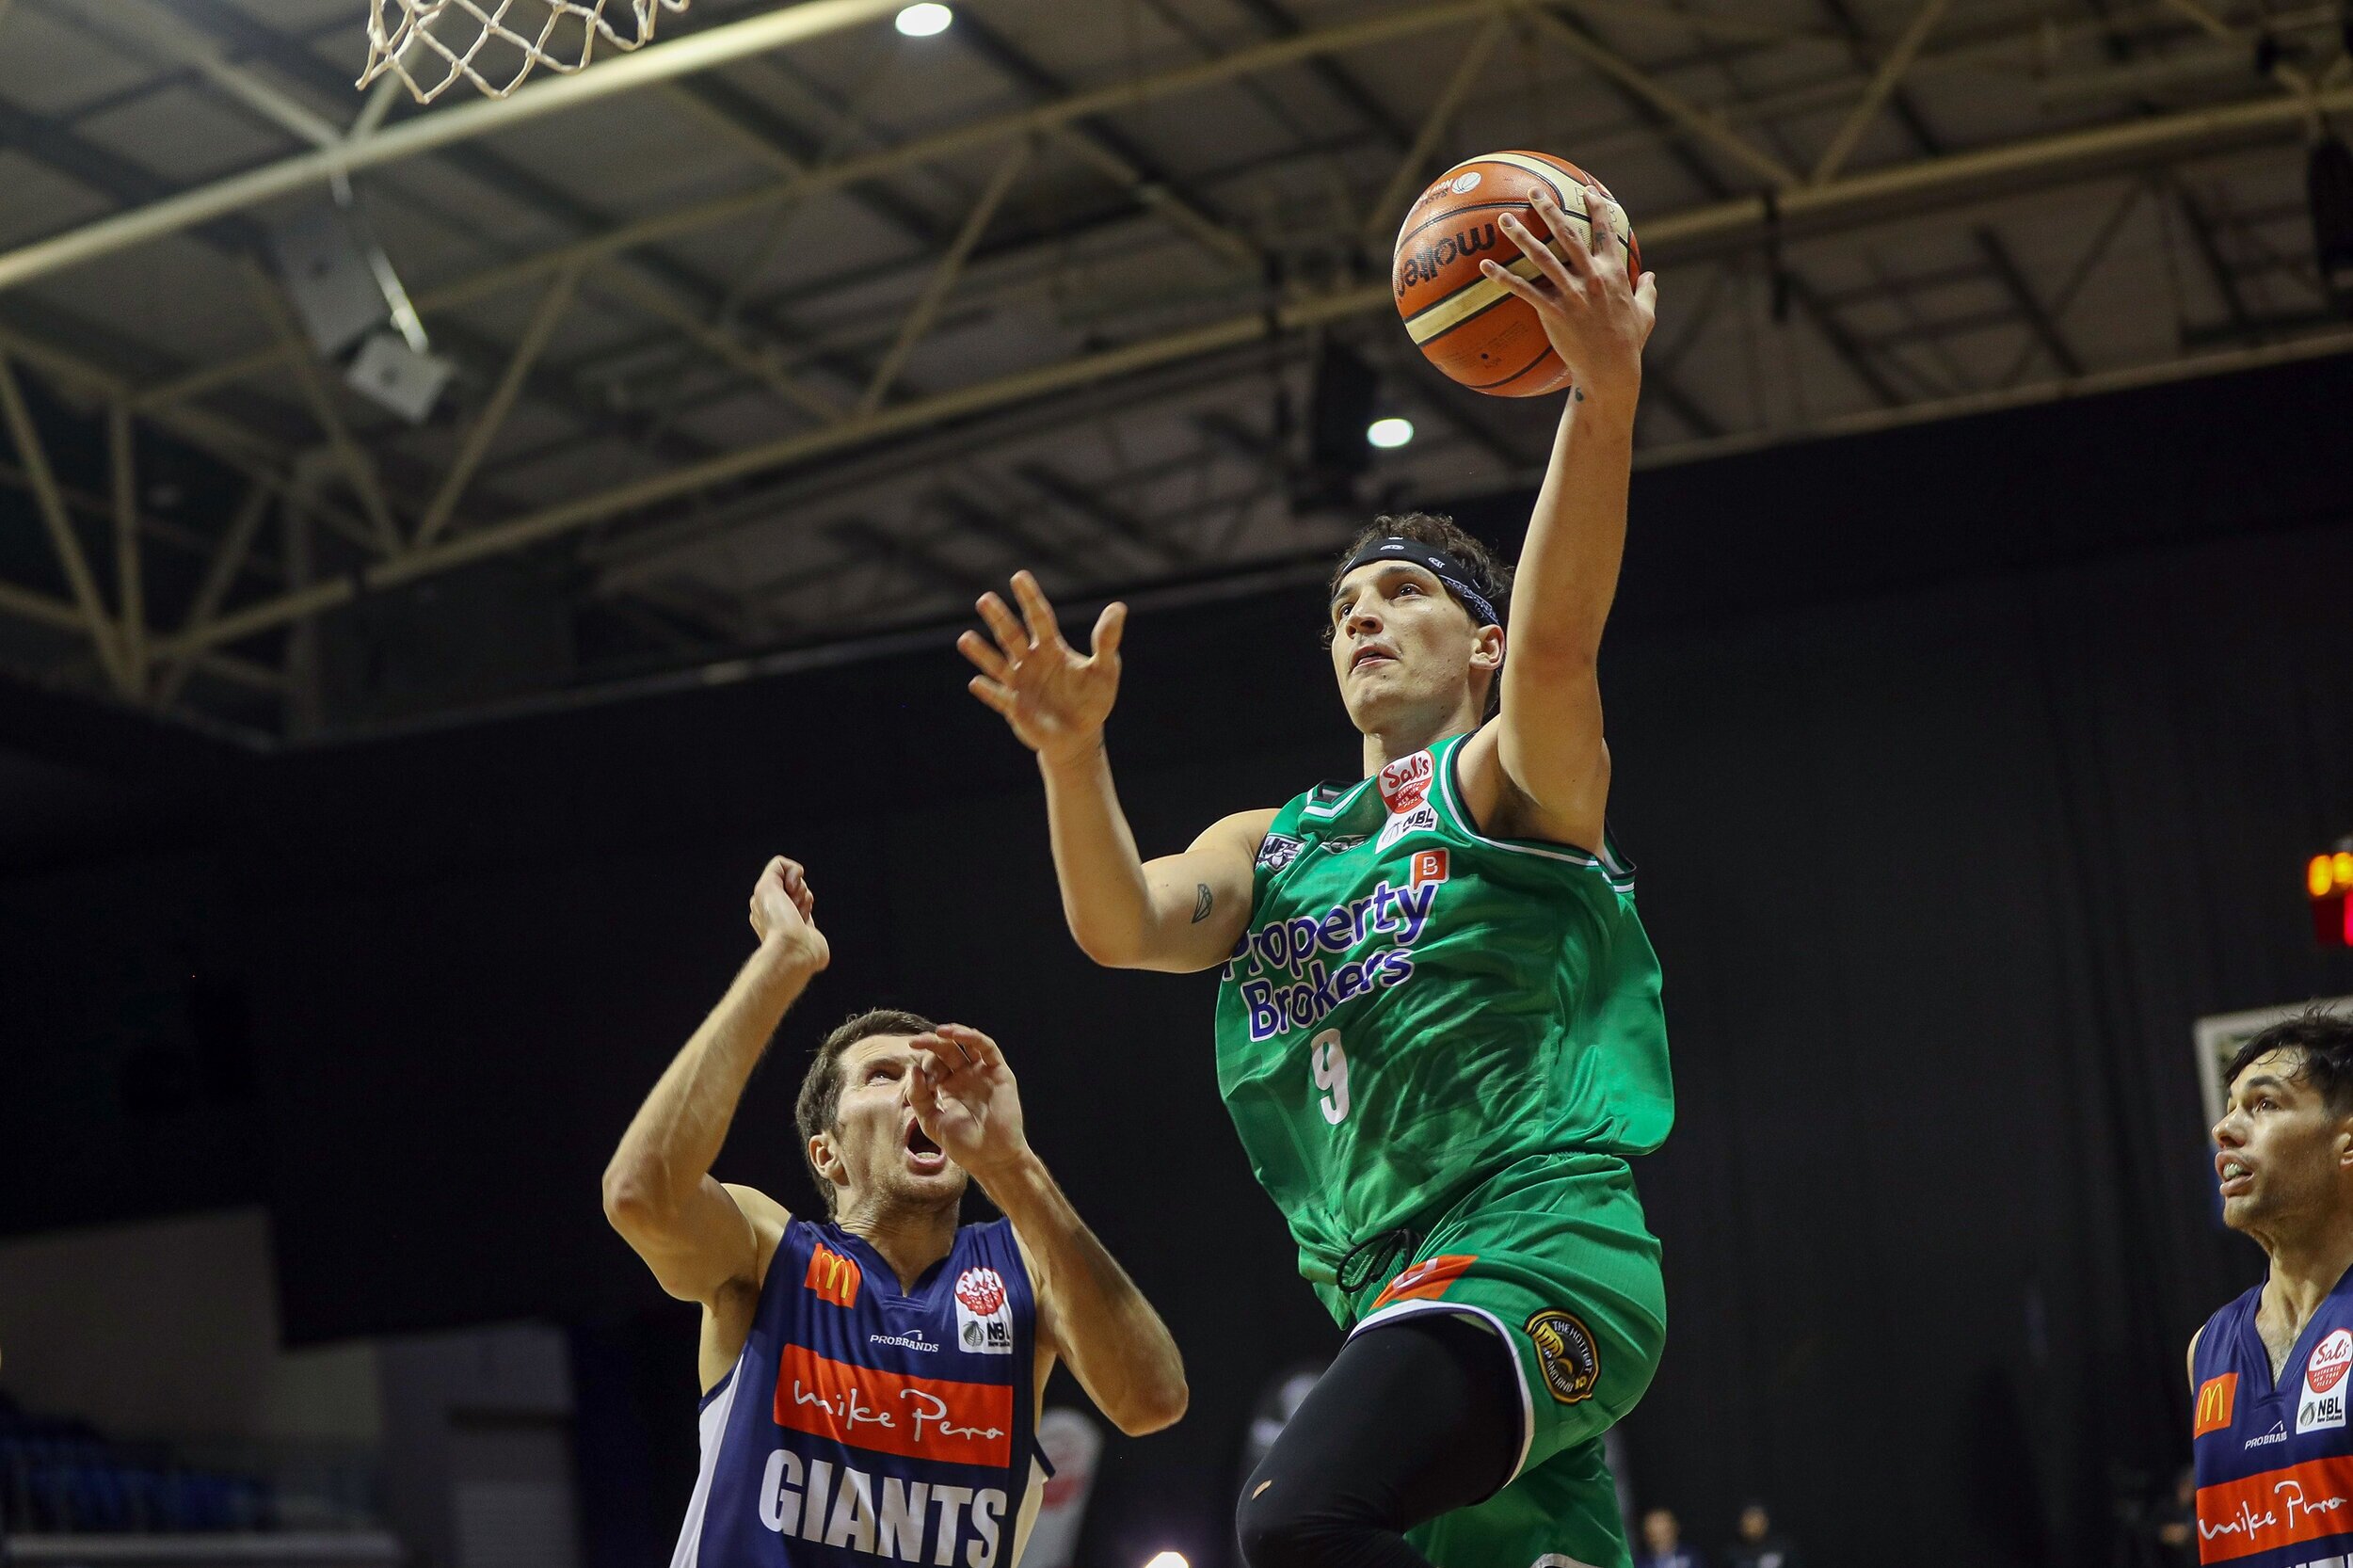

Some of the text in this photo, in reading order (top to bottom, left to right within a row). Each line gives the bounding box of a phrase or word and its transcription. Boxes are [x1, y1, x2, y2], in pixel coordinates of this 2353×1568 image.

[1395, 223, 1497, 298] molten
[1383, 755, 1430, 789] Sal's
[1402, 808, 1433, 828] NBL
[1241, 949, 1415, 1042] Brokers
[1311, 1028, 1351, 1126] 9
[1552, 1320, 1571, 1334] THE
[870, 1334, 939, 1352] PROBRANDS
[2316, 1338, 2350, 1366] Sal's
[2317, 1396, 2343, 1417] NBL
[759, 1448, 1007, 1568] GIANTS
